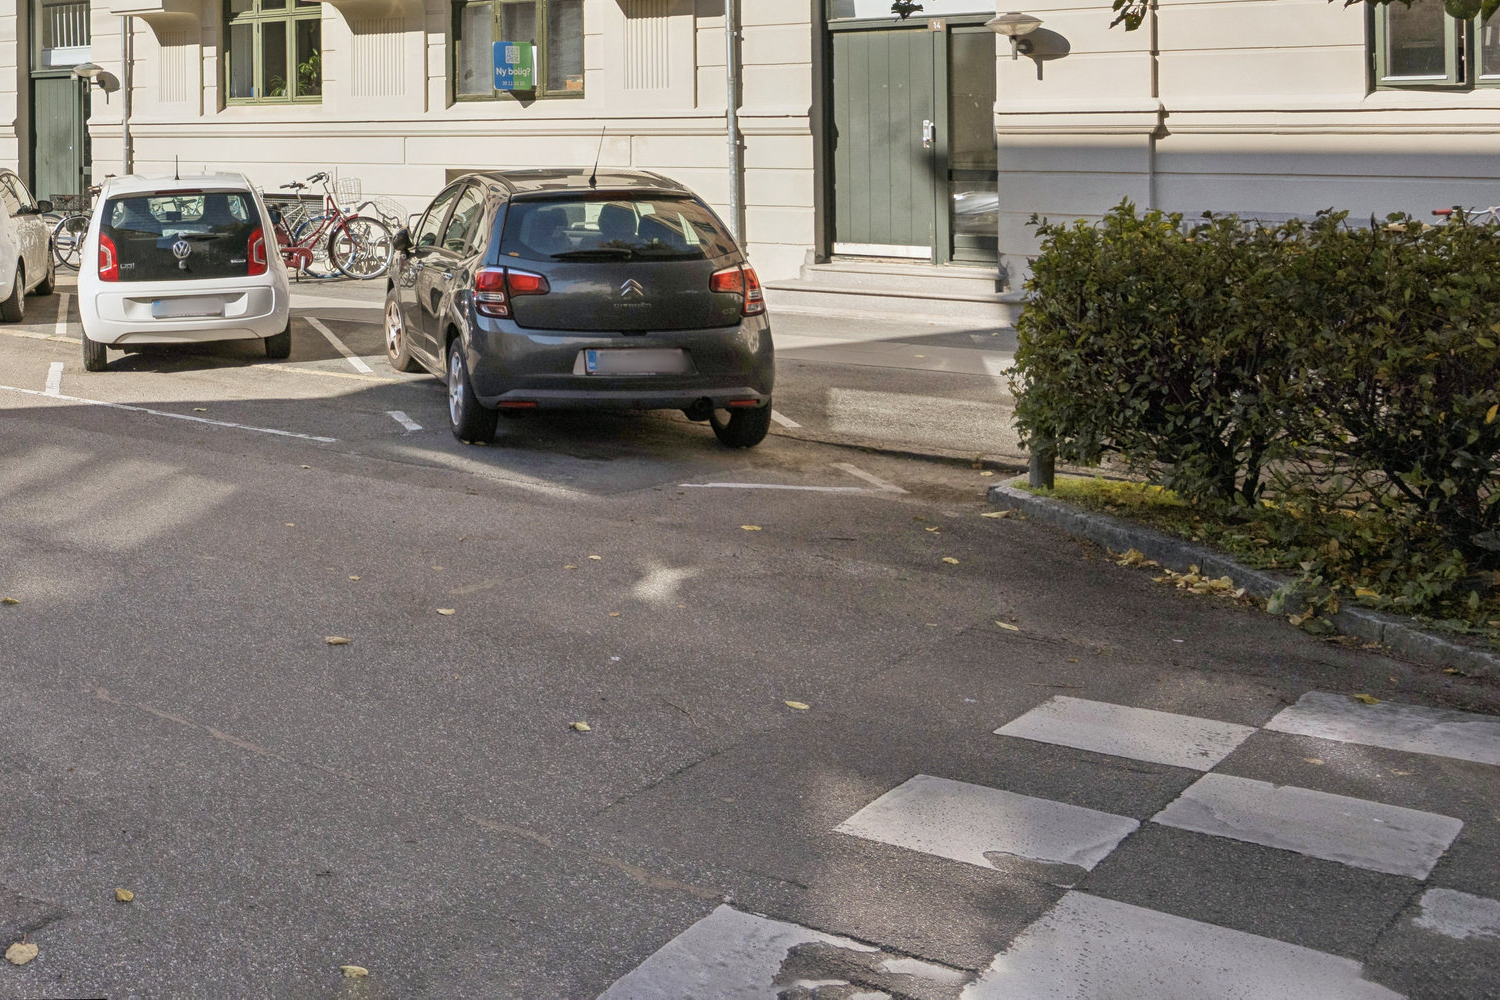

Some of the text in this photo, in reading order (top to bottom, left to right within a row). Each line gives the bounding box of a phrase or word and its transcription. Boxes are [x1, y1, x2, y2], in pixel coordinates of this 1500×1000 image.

[932, 21, 941, 29] 14
[495, 67, 531, 77] Ny bolig?
